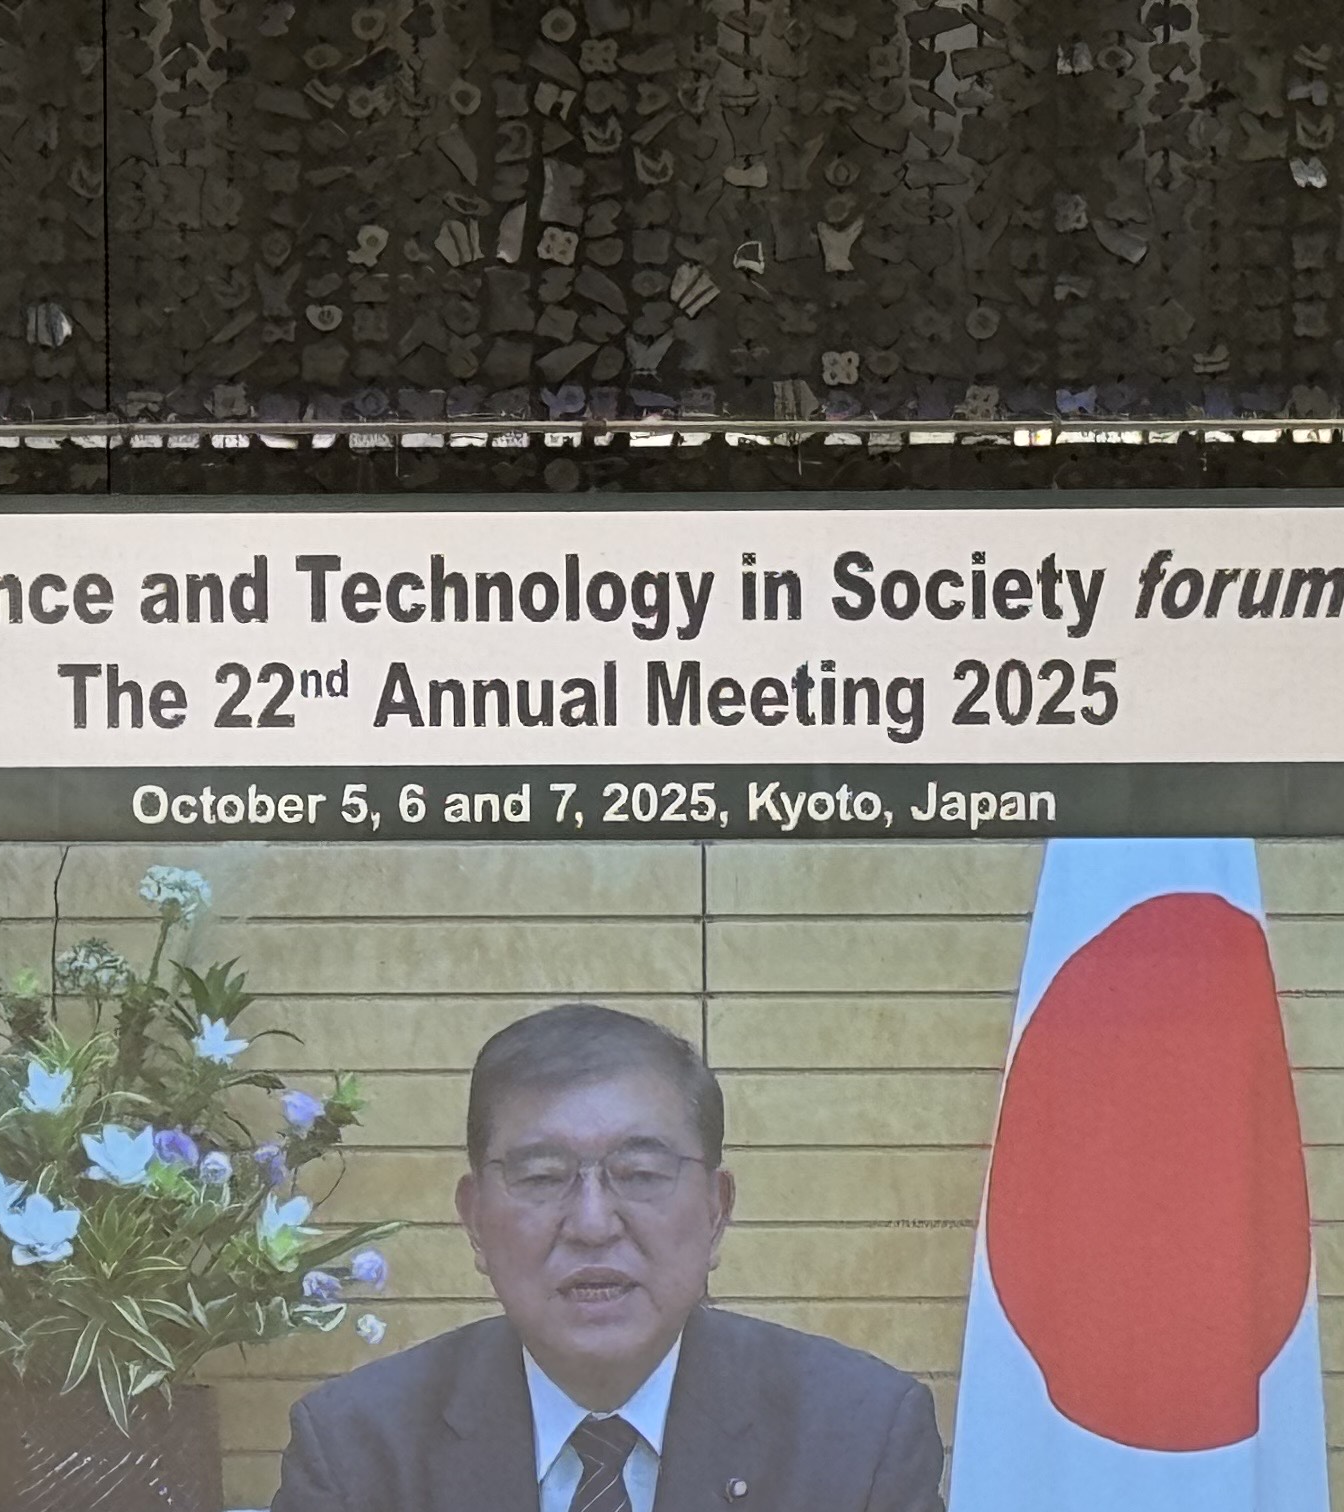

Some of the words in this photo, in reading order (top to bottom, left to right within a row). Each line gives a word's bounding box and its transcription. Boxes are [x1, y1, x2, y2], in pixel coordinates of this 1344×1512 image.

[140, 554, 269, 625] and
[295, 553, 715, 641] Technology
[741, 552, 802, 621] in
[831, 550, 1107, 639] Society
[57, 663, 188, 730] The
[213, 658, 349, 729] 22nd
[372, 659, 617, 728] Annual
[646, 659, 925, 745] Meeting
[951, 658, 1119, 727] 2025
[132, 783, 327, 825] October
[341, 783, 381, 832] 5,
[398, 783, 426, 823] 6
[443, 783, 531, 823] and
[549, 783, 584, 829] 7,
[602, 782, 729, 828] 2025,
[748, 781, 893, 832] Kyoto,
[910, 781, 1056, 831] Japan
